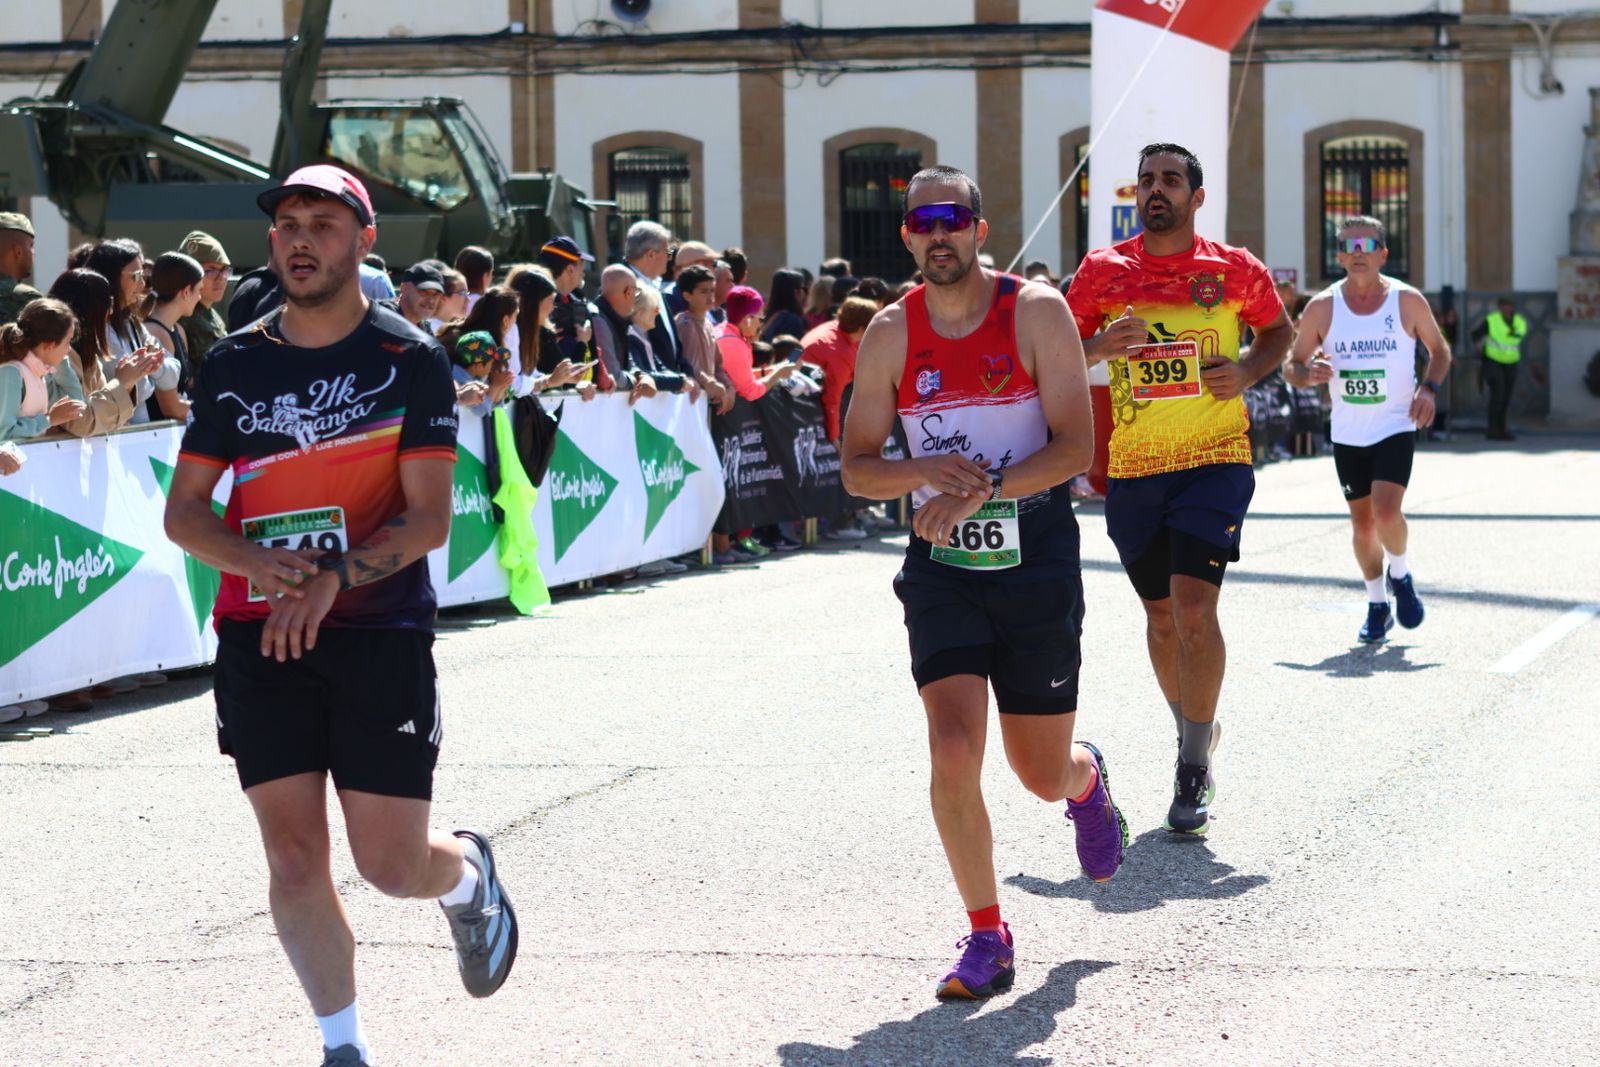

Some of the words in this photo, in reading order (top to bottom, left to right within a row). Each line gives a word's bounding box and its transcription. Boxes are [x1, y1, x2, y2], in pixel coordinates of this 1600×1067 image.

[1334, 341, 1347, 353] LA
[1350, 337, 1397, 352] ARMUÑA
[1138, 358, 1187, 385] 399
[309, 371, 370, 411] 21k
[1345, 380, 1379, 395] 693
[236, 400, 376, 436] Salamanca
[921, 413, 971, 451] Simón
[277, 449, 299, 461] CON
[551, 471, 562, 501] El
[560, 471, 581, 500] Corte
[579, 463, 606, 509] Inglés
[268, 521, 314, 535] CARRERA
[4, 551, 52, 591] Corte
[54, 535, 115, 600] Inglés
